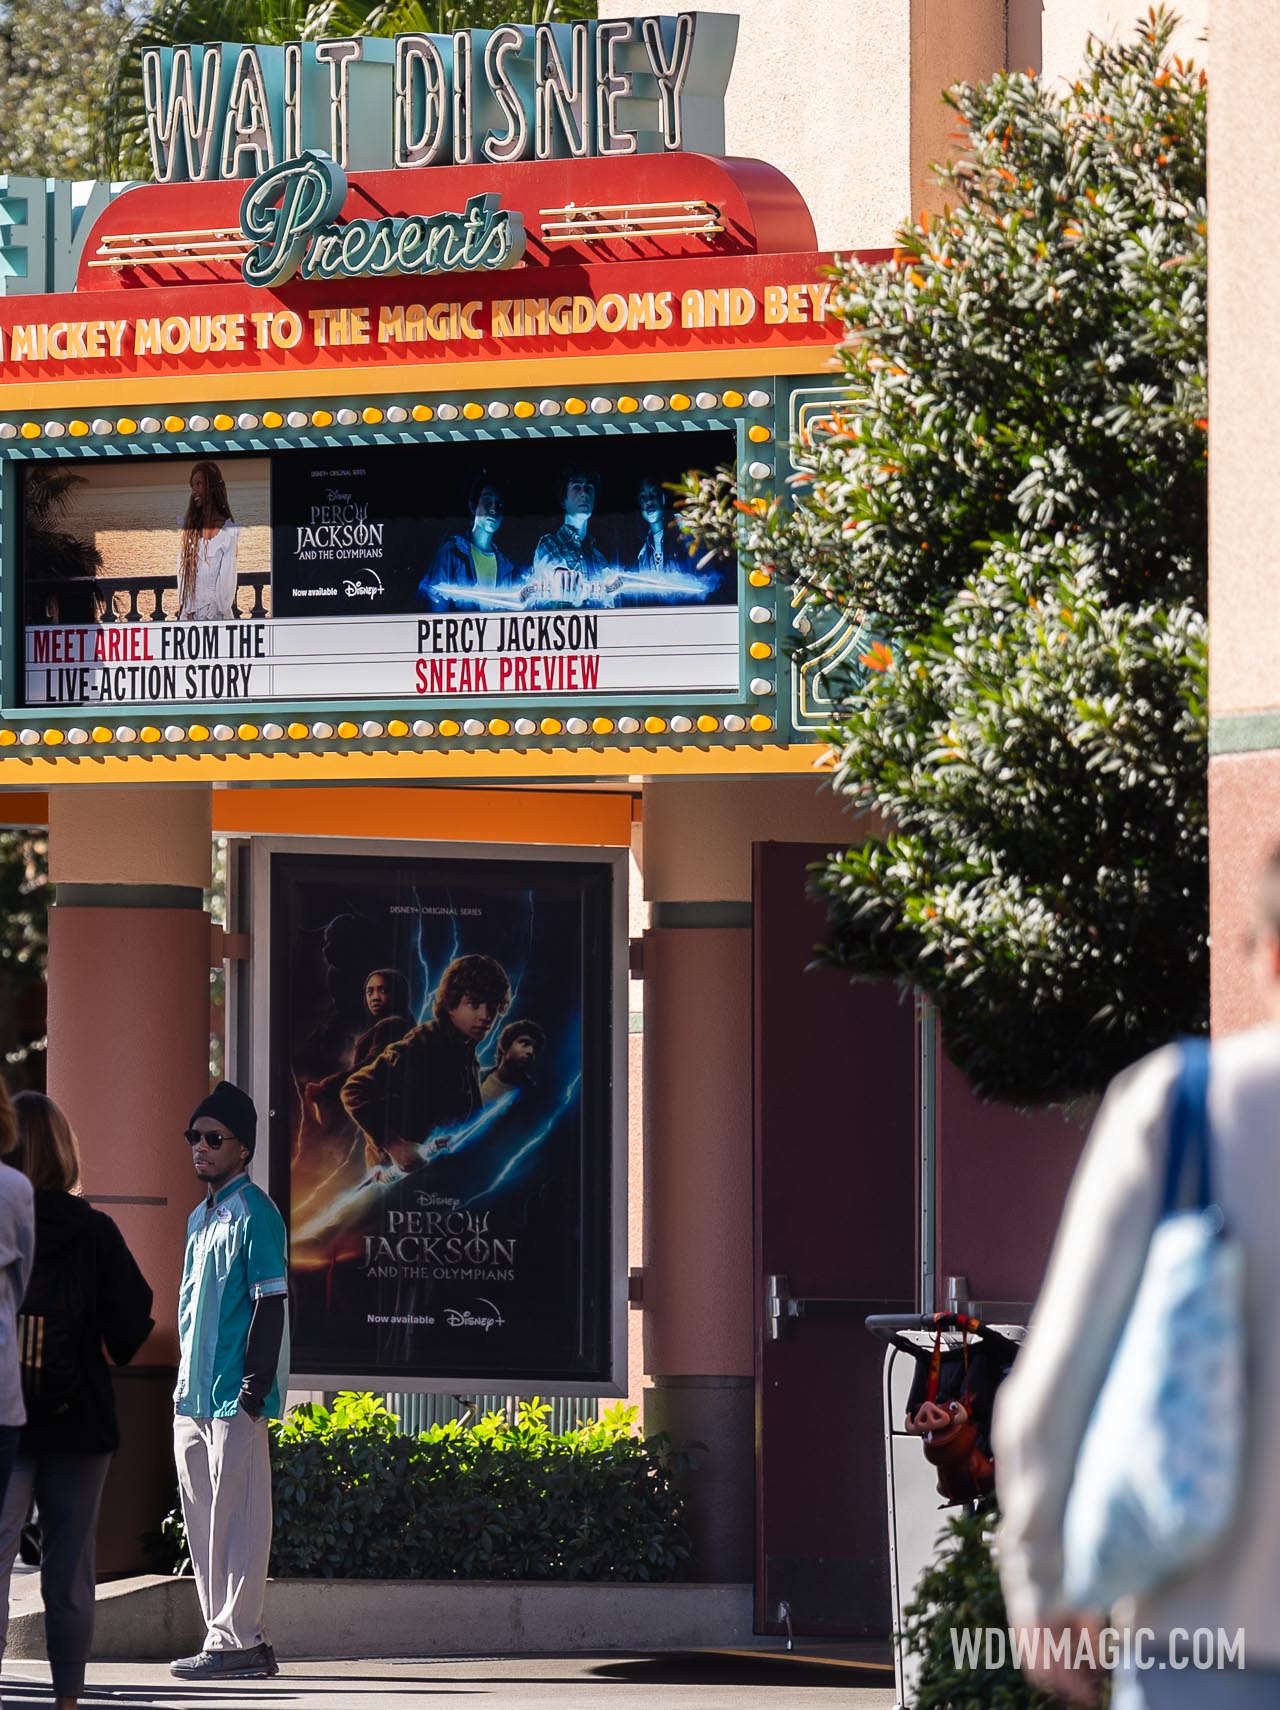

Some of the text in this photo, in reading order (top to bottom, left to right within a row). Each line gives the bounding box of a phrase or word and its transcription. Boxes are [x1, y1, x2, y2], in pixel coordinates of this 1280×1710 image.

[140, 12, 700, 183] WALT DISNEY
[241, 151, 522, 288] Presents
[11, 319, 128, 362] MICKEY
[134, 313, 246, 355] MOUSE
[251, 310, 304, 350] TO
[308, 307, 371, 347] THE
[377, 300, 484, 343] MAGIC
[491, 291, 673, 338] KINGDOMS
[681, 286, 756, 329] AND
[310, 502, 369, 526] PERCY
[293, 523, 384, 555] JACKSON
[299, 548, 383, 561] AND THE OLYMPIANS
[292, 572, 385, 600] Now available Disney+
[33, 623, 266, 664] MEET ARIEL FROM THE
[417, 614, 599, 654] PERCY JACKSON
[46, 663, 253, 703] LIVE-ACTION STORY
[415, 655, 600, 695] SNEAK PREVIEW
[389, 905, 482, 917] DISNEY+ ORIGINAL SERIES
[414, 1189, 461, 1211] Disney
[387, 1210, 490, 1238] PERCY
[357, 1235, 517, 1270] JACKSON
[367, 1266, 515, 1281] AND THE OLYMPIANS
[367, 1301, 506, 1332] Now available Disney+
